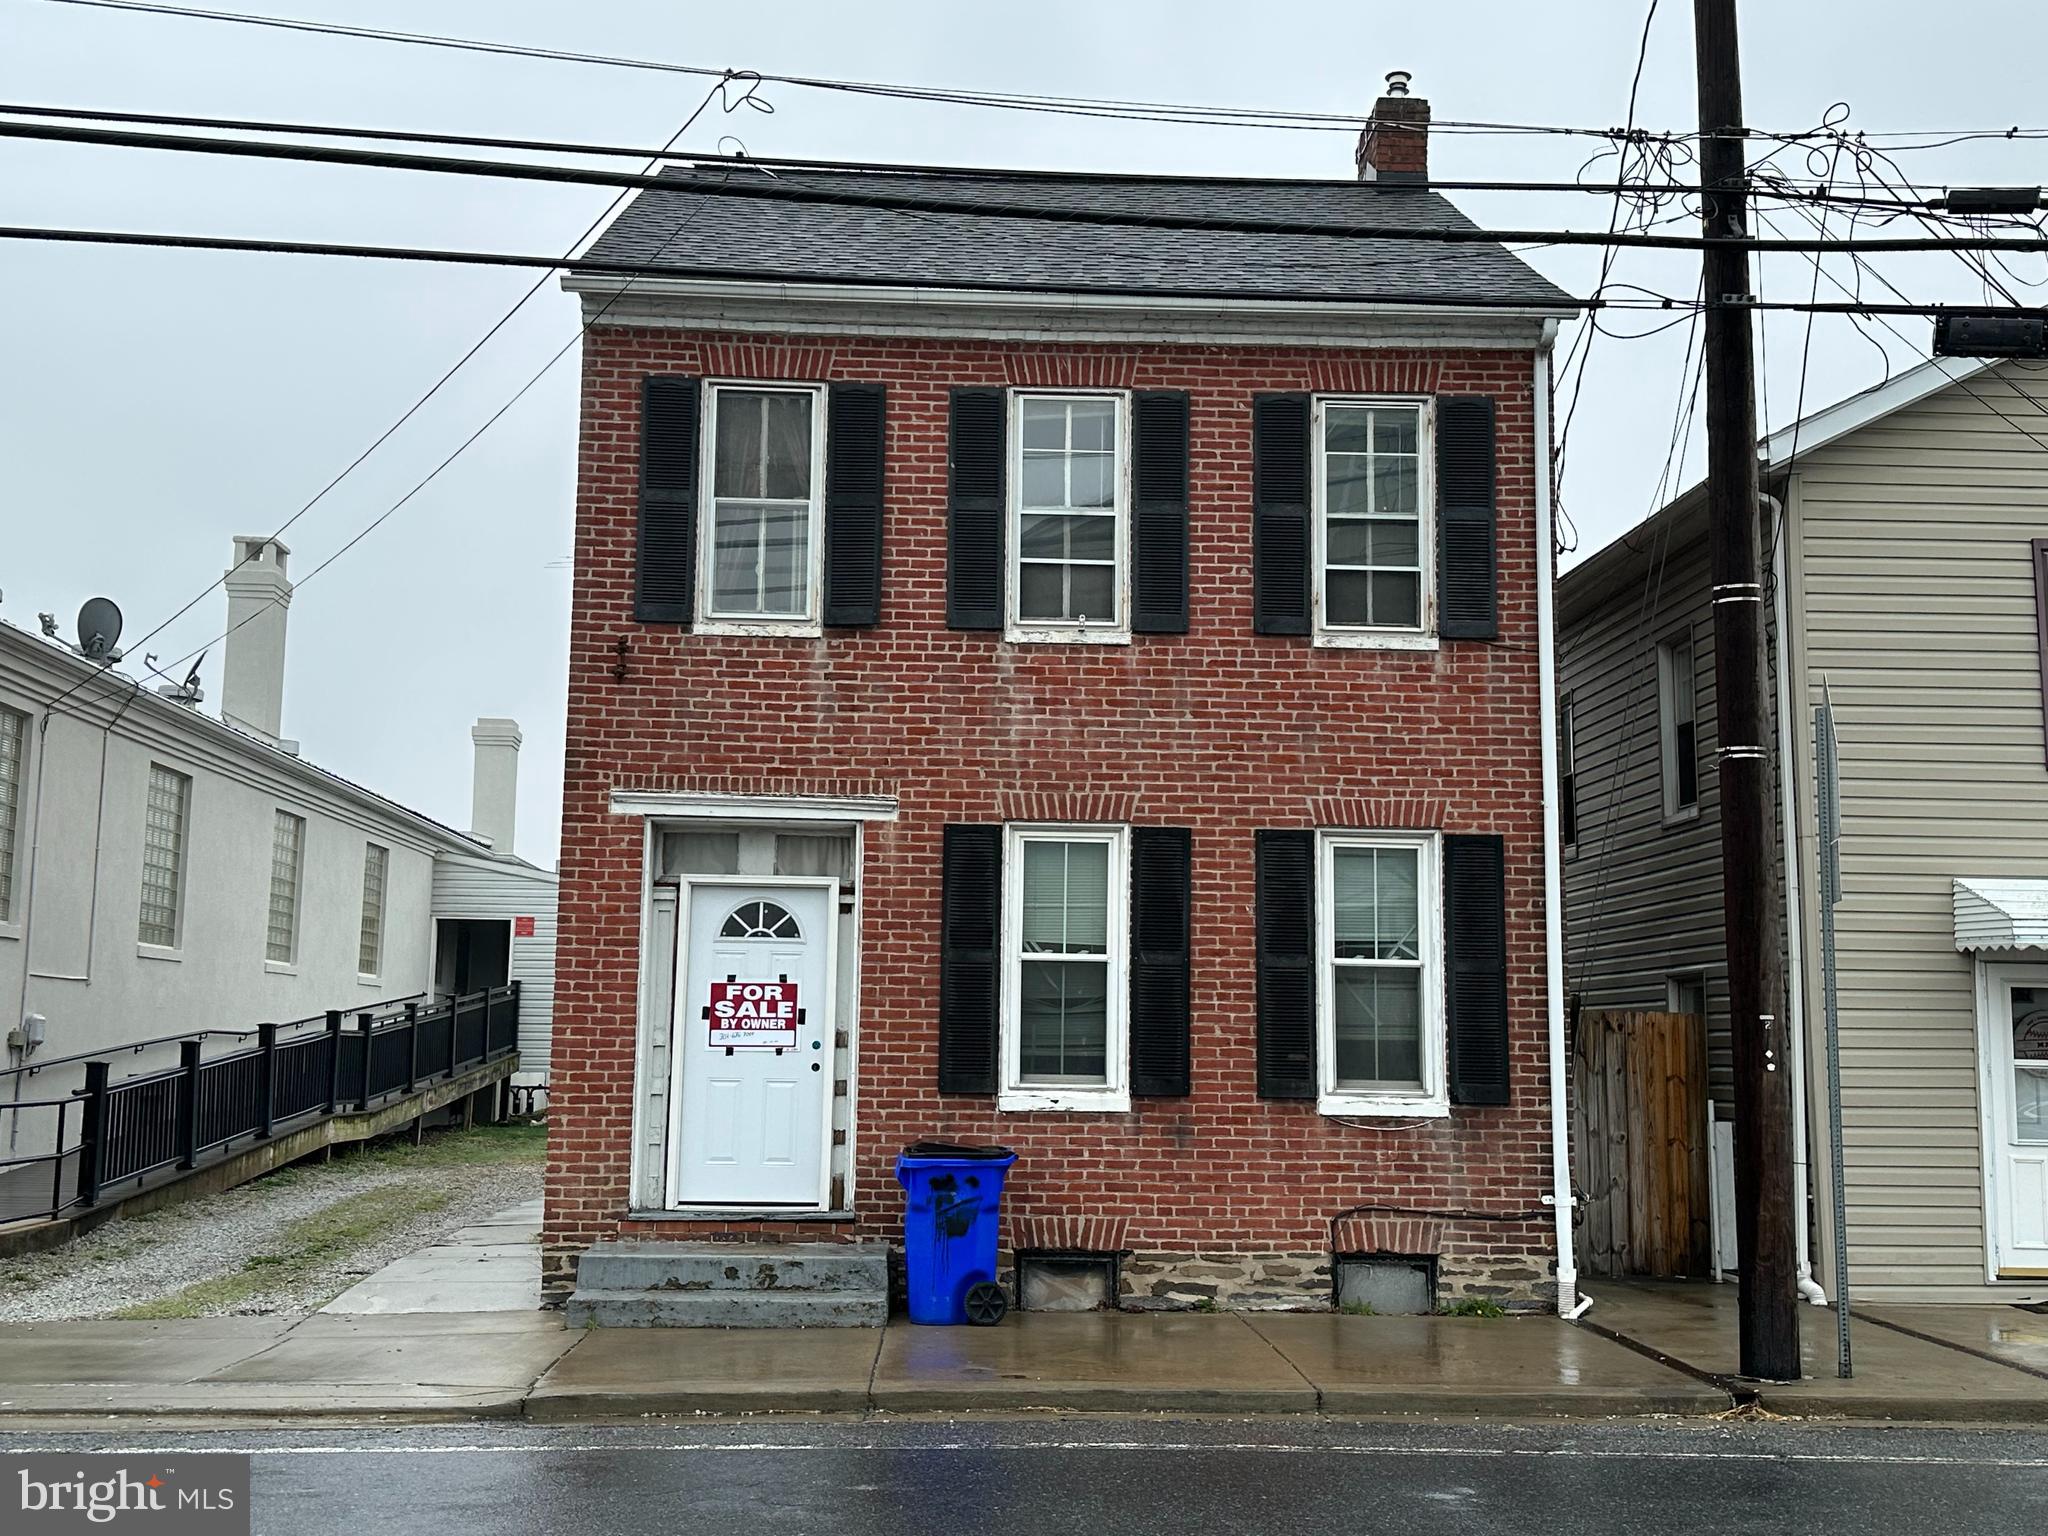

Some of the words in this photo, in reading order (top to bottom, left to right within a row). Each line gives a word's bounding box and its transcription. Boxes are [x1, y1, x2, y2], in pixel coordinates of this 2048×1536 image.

[726, 985, 783, 1000] FOR
[714, 1001, 793, 1018] SALE
[721, 1019, 738, 1029] BY
[741, 1019, 786, 1029] OWNER
